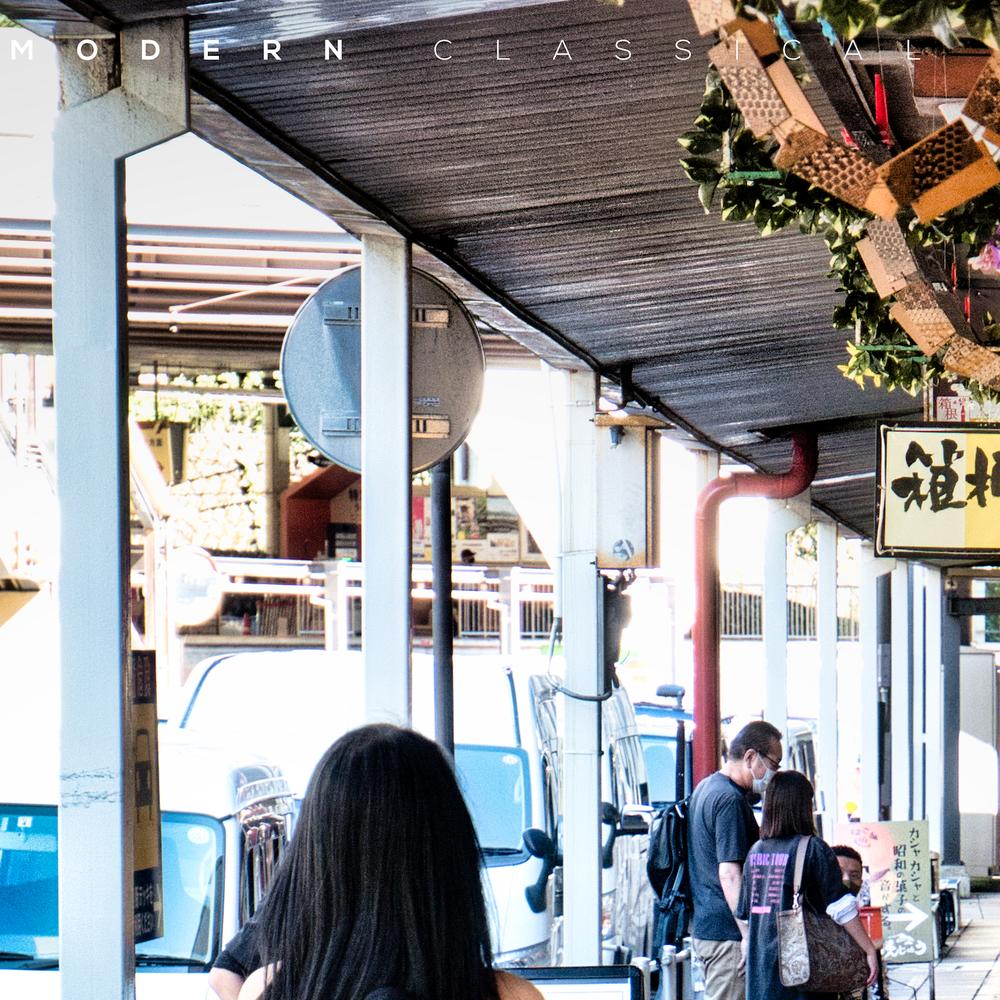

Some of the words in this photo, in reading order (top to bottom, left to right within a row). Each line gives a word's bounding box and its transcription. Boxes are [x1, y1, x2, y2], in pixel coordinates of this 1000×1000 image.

[909, 827, 922, 903] カシャカシャと
